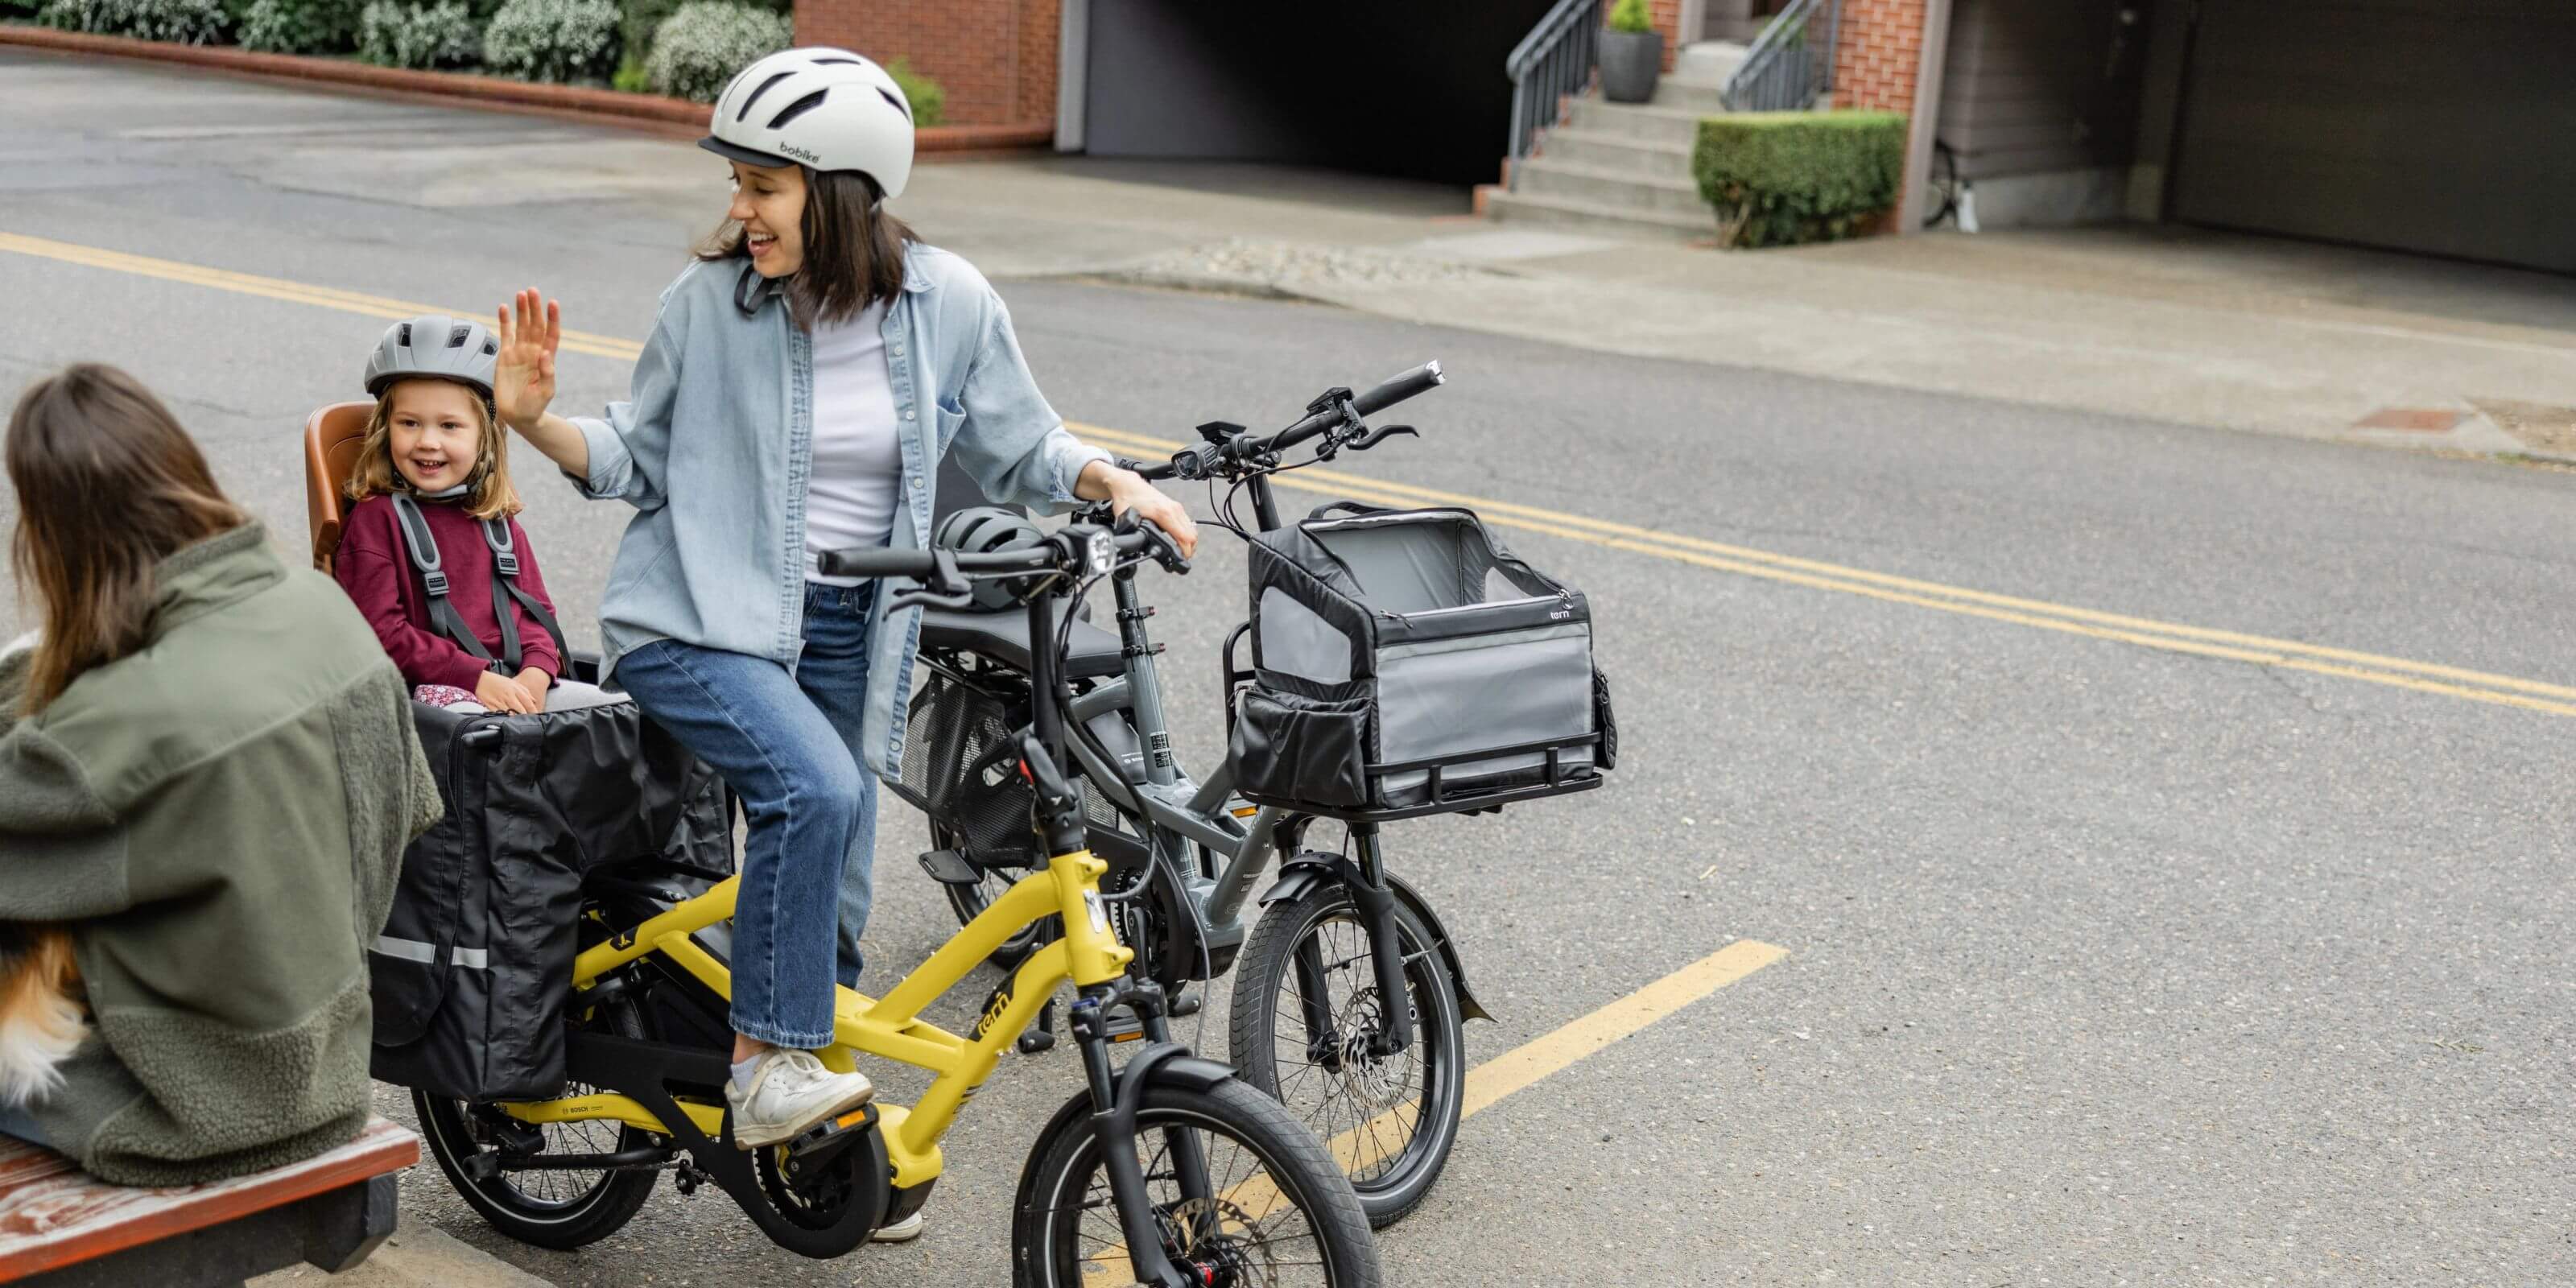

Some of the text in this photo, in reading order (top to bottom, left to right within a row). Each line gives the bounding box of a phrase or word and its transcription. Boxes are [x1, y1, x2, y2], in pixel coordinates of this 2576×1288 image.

[780, 142, 819, 163] bobike
[1550, 610, 1570, 619] tern
[978, 993, 1010, 1037] tern
